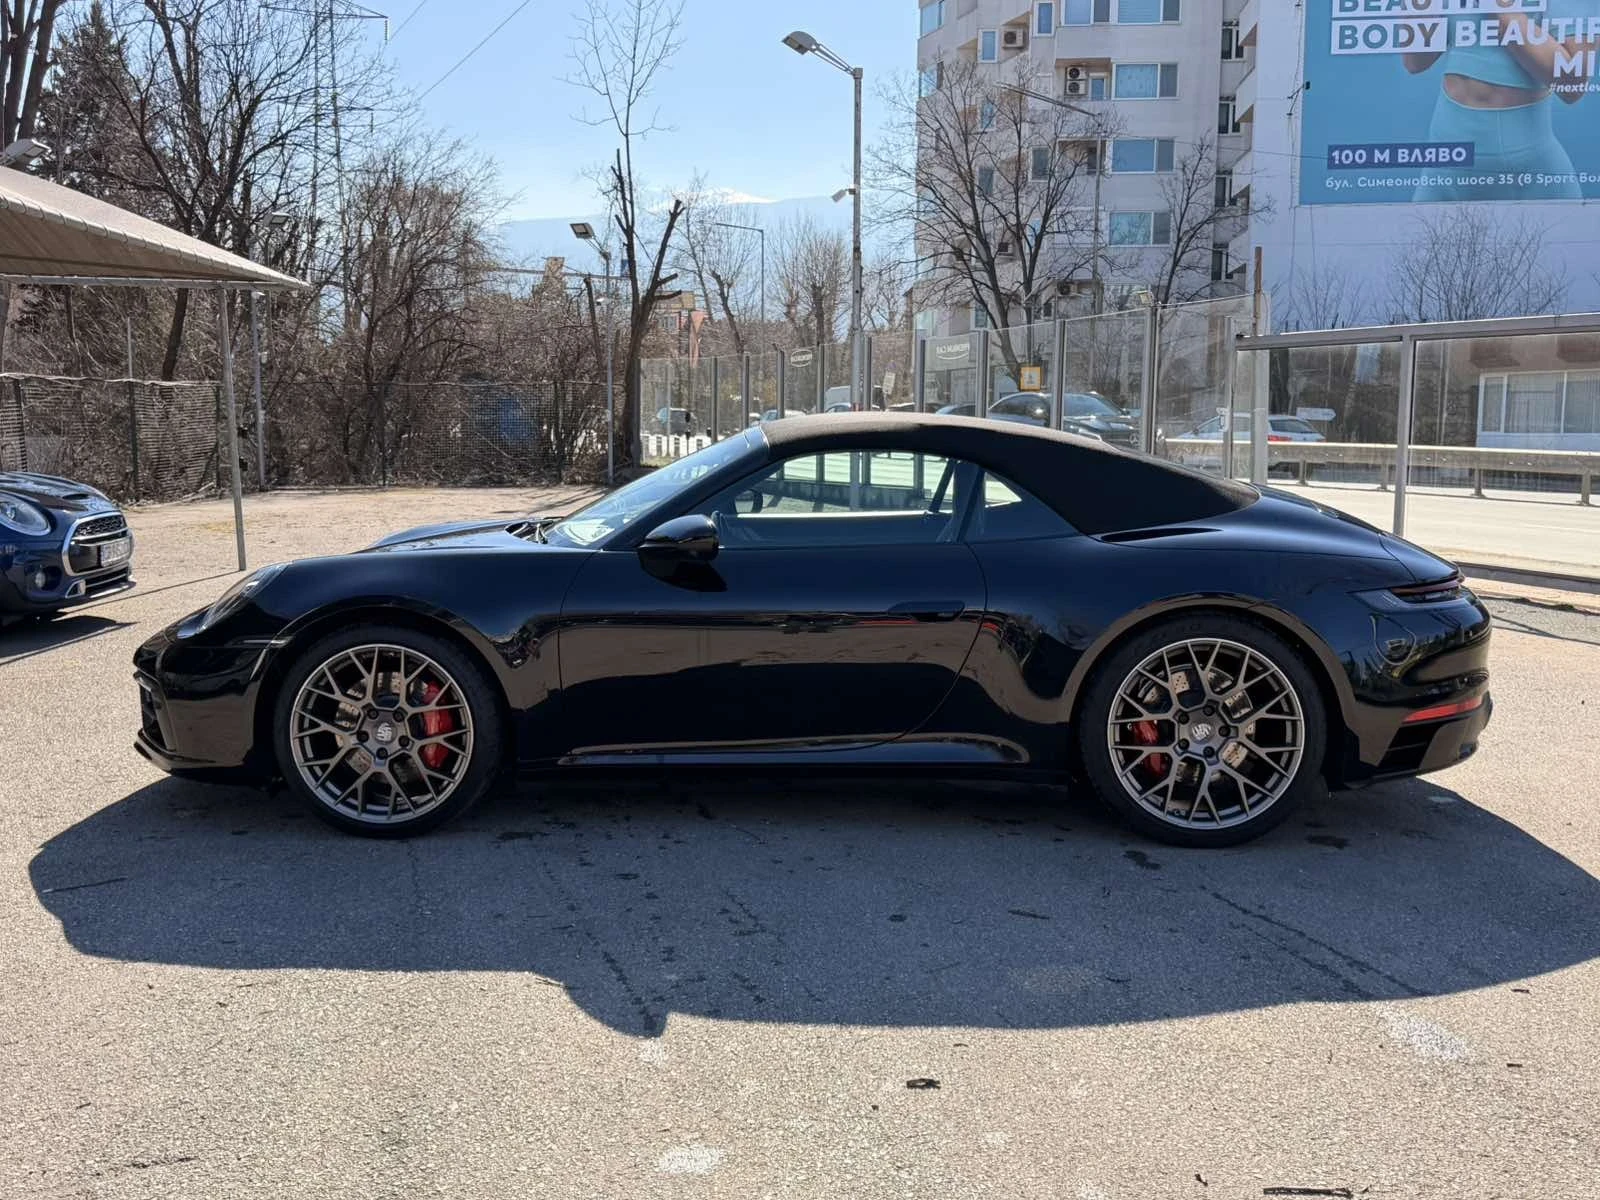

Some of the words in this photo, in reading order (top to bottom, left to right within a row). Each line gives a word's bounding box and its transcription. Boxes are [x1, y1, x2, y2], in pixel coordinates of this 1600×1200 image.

[1338, 23, 1440, 49] BODY
[1553, 50, 1600, 77] MI
[1331, 149, 1367, 164] 100
[1374, 148, 1390, 163] М
[1397, 147, 1466, 163] ВЛЯВО
[1325, 176, 1353, 191] бул.
[1357, 175, 1453, 188] Симеоновско
[1457, 175, 1494, 185] шосе
[1498, 173, 1514, 184] 35
